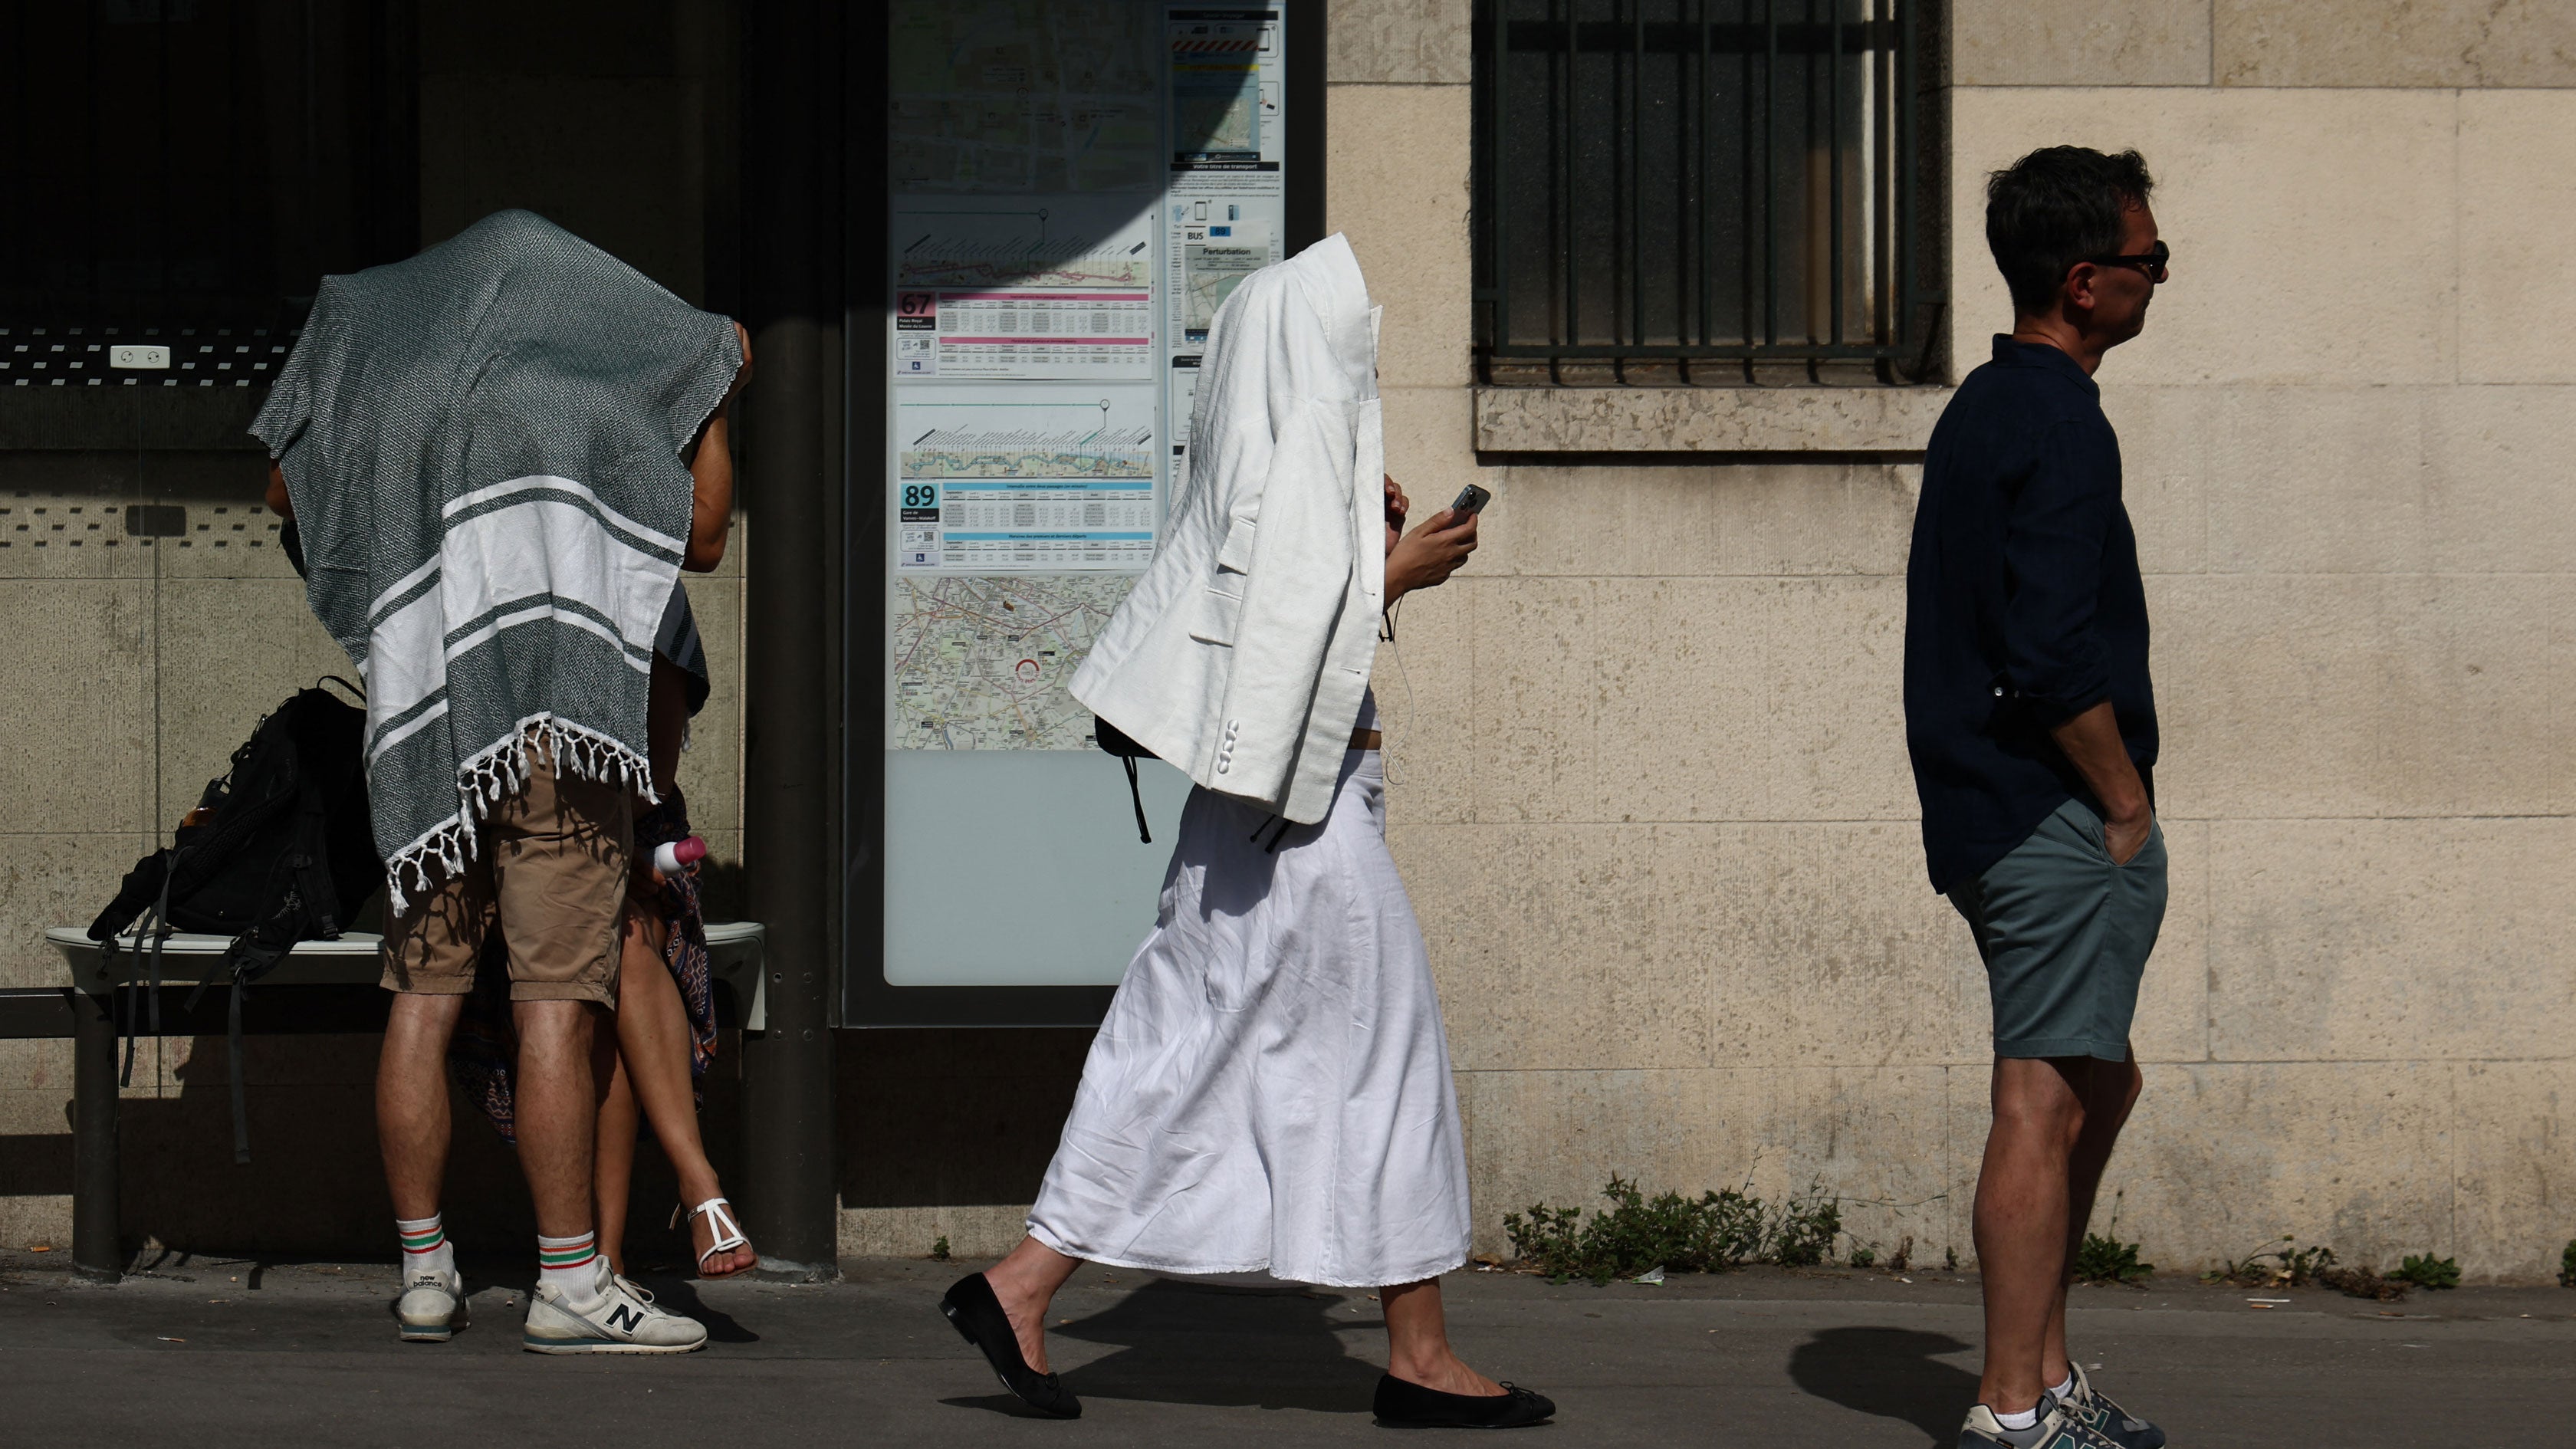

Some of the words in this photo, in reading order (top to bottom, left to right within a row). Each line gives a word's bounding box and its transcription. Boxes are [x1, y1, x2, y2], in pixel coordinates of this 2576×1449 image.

[1214, 227, 1227, 235] 89
[902, 294, 932, 314] 67
[905, 485, 935, 506] 89
[606, 1303, 646, 1336] N
